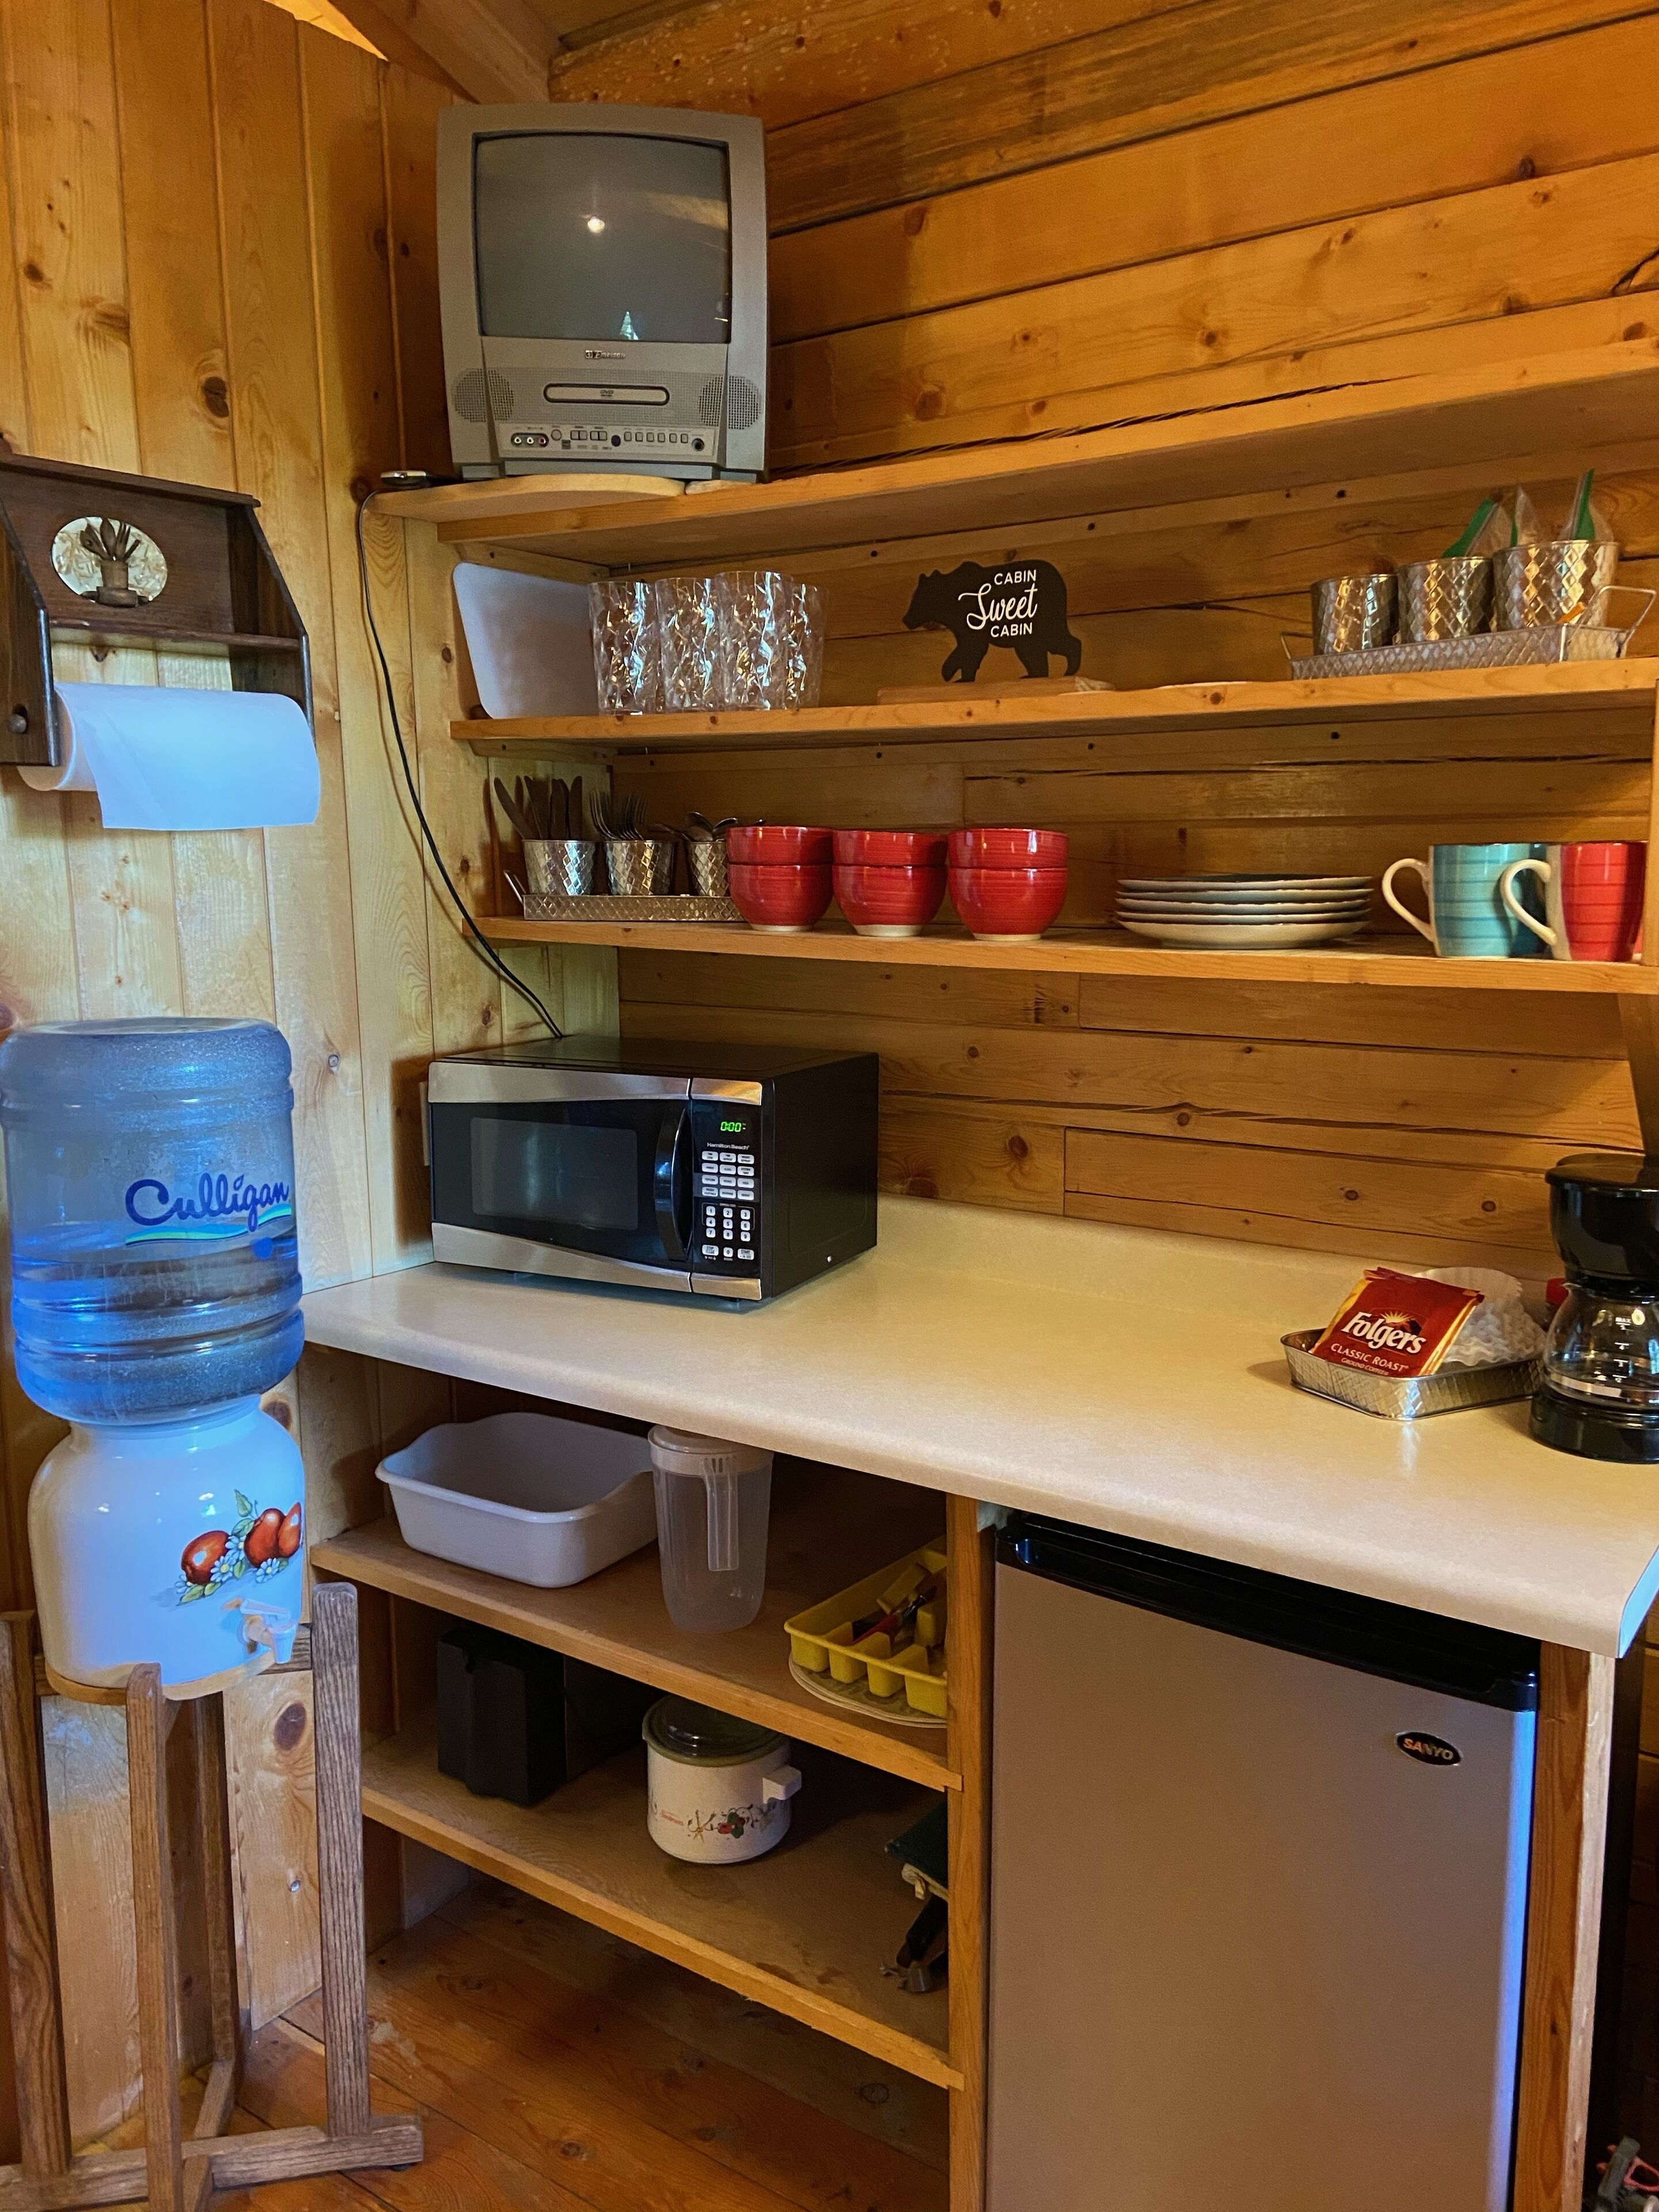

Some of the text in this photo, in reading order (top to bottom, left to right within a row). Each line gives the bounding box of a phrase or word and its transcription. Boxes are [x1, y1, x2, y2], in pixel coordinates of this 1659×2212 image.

[994, 569, 1036, 585] CABIN
[958, 582, 1038, 630] Sweet
[990, 622, 1033, 638] CABIN
[126, 1173, 289, 1233] Culligan
[1341, 1311, 1427, 1354] Folgers
[1331, 1343, 1409, 1373] CLASSIC ROAST
[1340, 1357, 1365, 1369] GROUND
[1403, 1738, 1454, 1760] SANYO
